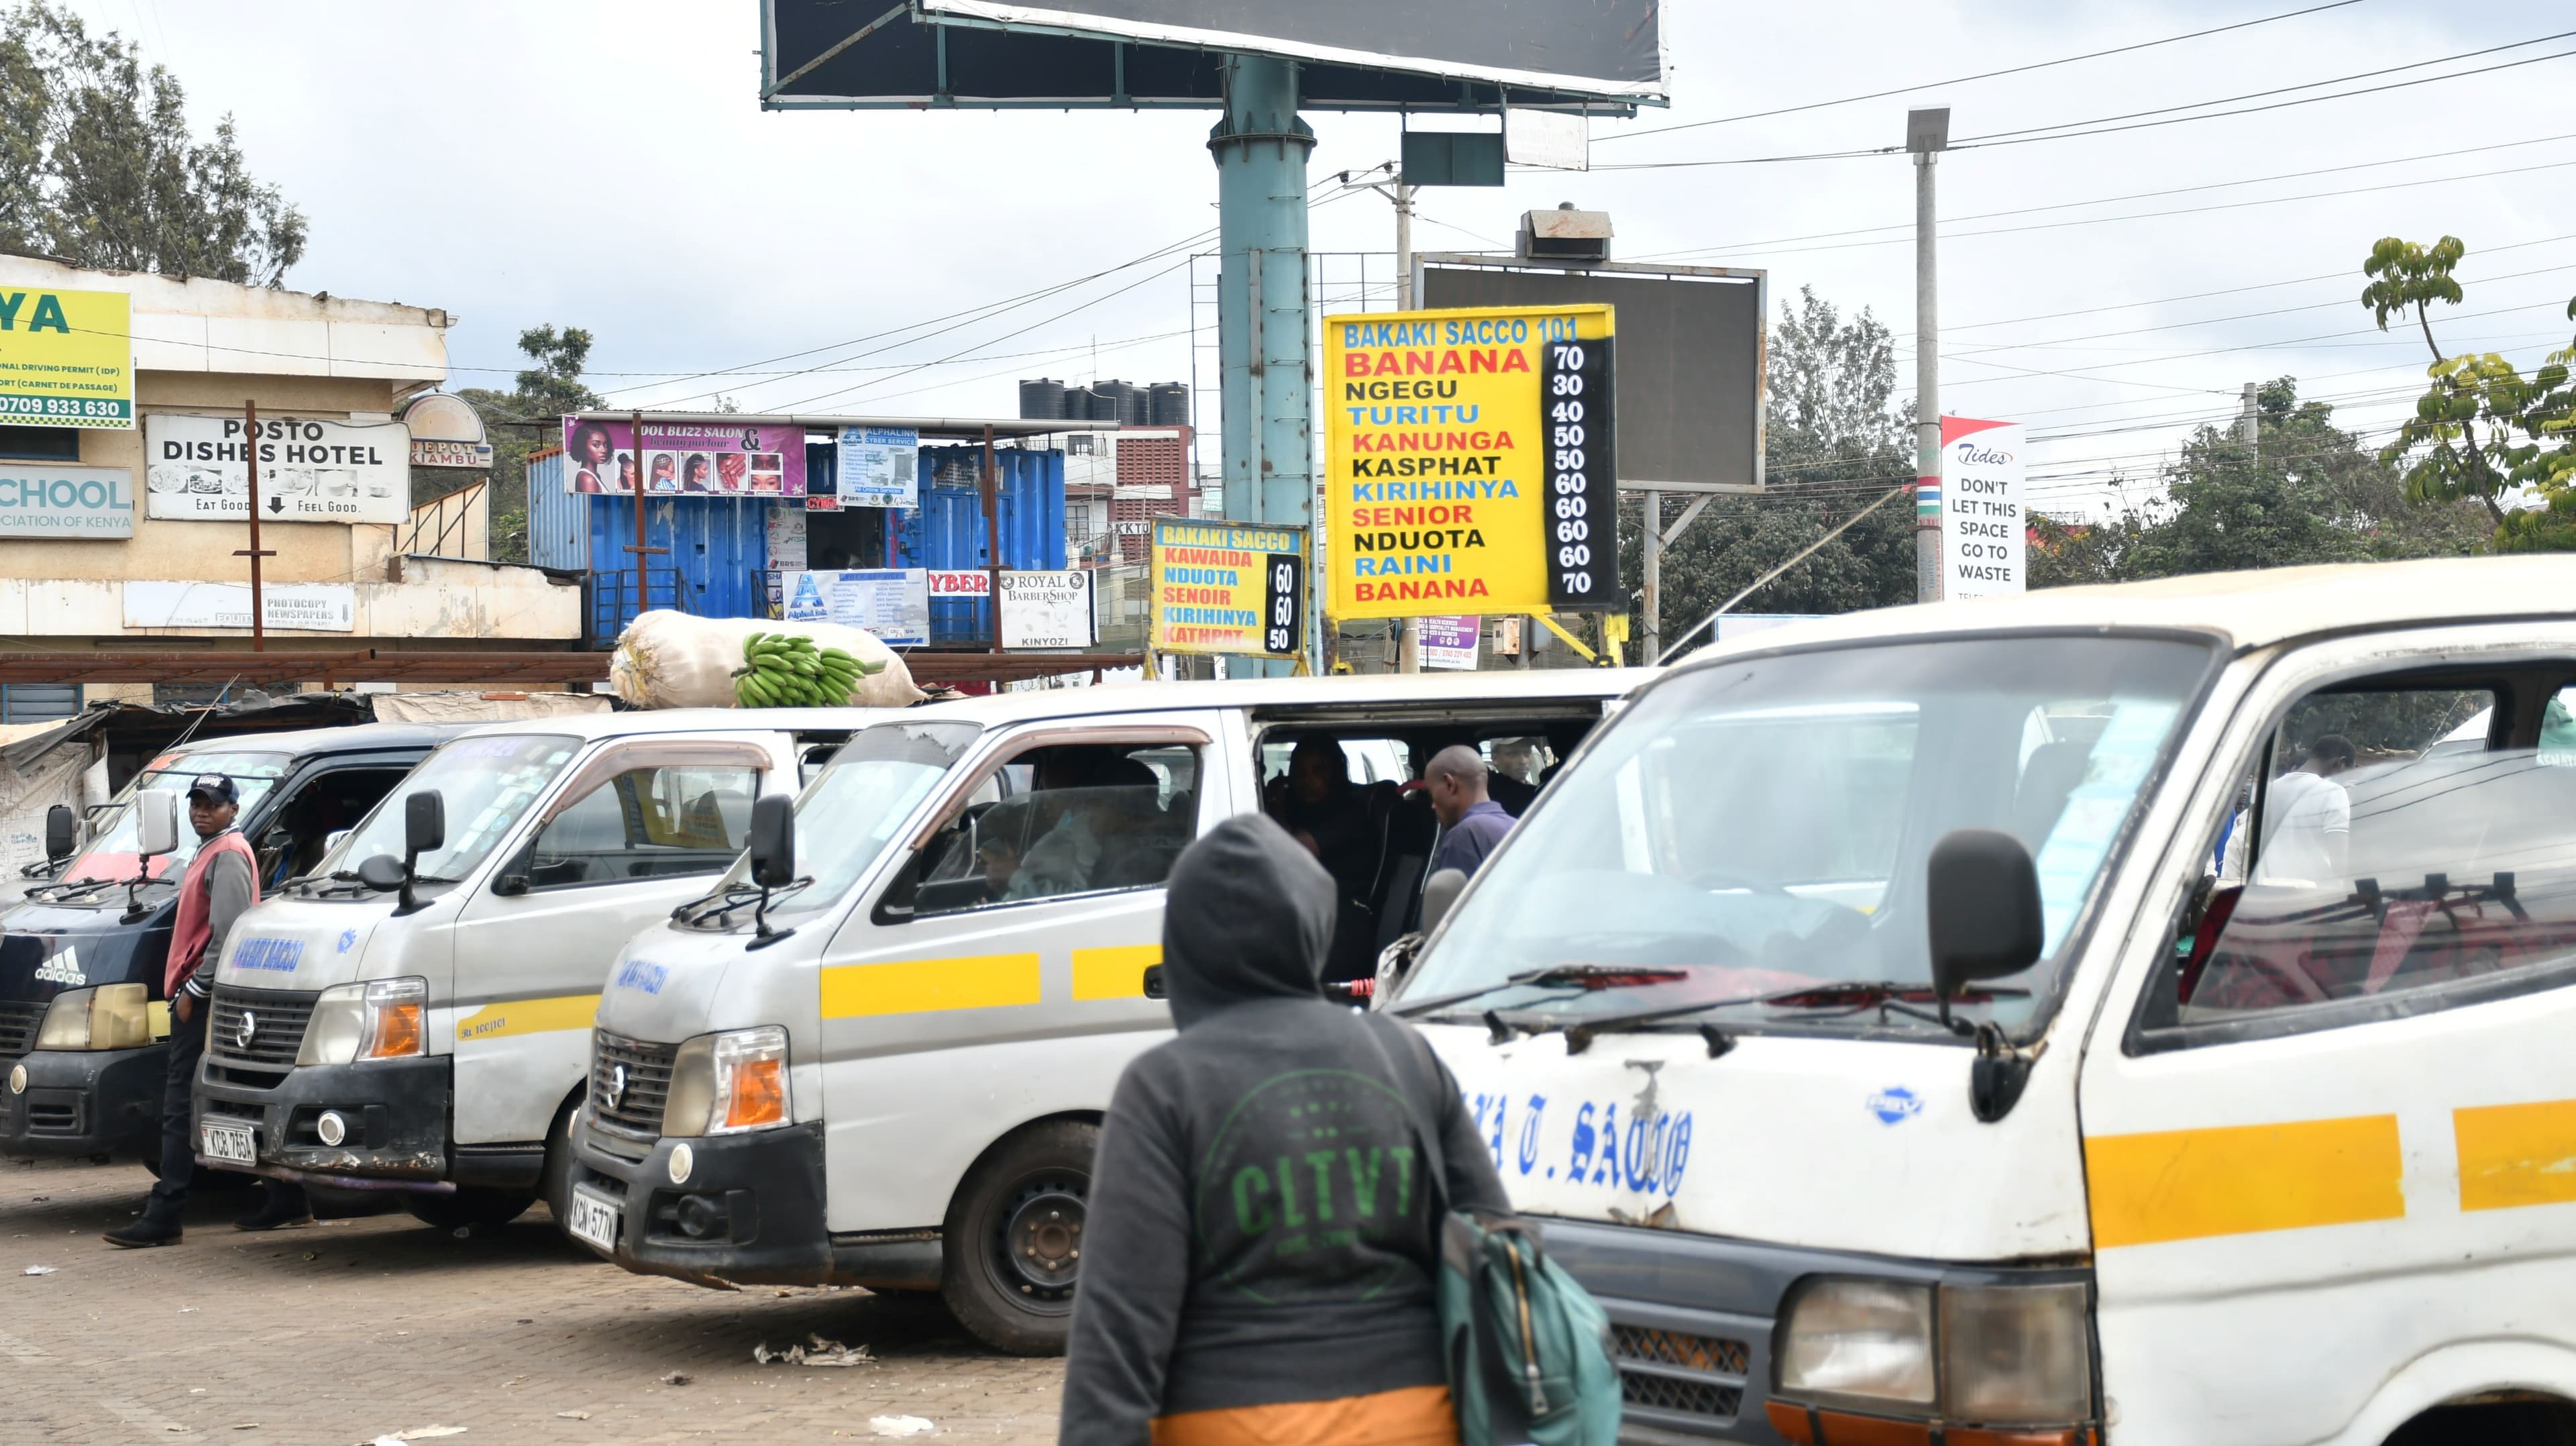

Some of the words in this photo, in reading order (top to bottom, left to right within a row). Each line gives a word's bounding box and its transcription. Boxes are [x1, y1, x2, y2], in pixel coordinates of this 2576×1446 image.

[1344, 321, 1436, 348] BAKAKI
[1445, 319, 1527, 344] SACCO
[1538, 317, 1577, 344] 101
[1345, 349, 1529, 377] BANANA
[1554, 346, 1584, 370] 70
[17, 379, 57, 389] (CARNET
[72, 383, 117, 393] PASSAGE)
[1346, 380, 1457, 401] NGEGU
[1553, 375, 1582, 395] 30
[0, 397, 42, 413] 0709
[47, 399, 80, 415] 933
[85, 401, 119, 416] 630
[1347, 405, 1479, 426] TURITU
[1552, 401, 1583, 422] 40
[224, 420, 324, 441] POSTO
[667, 426, 702, 437] BLIZZ
[704, 427, 744, 438] SALON
[741, 428, 761, 451] &
[867, 428, 916, 437] ALPHALINK
[1352, 431, 1514, 452] KANUNGA
[1554, 425, 1584, 447] 50
[164, 441, 276, 463] DISHES
[286, 445, 383, 465] HOTEL
[651, 437, 686, 448] beauty
[410, 454, 476, 464] KIAMBU
[1352, 456, 1501, 477] KASPHAT
[1554, 449, 1585, 470] 50
[1958, 444, 2006, 465] Tides
[0, 478, 131, 509] CHOOL
[1352, 480, 1519, 502] KIRIHINYA
[1555, 474, 1586, 494] 60
[1961, 478, 2008, 495] DON'T
[1352, 505, 1472, 527] SENIOR
[1556, 497, 1587, 519] 60
[1952, 499, 1978, 514] LET
[1982, 501, 2017, 517] THIS
[0, 515, 60, 527] CIATION
[64, 516, 83, 527] OF
[87, 517, 131, 527] KENYA
[1960, 521, 2008, 538] SPACE
[1163, 525, 1227, 548] BAKAKI
[1232, 531, 1290, 551] SACCO
[1354, 529, 1485, 552] NDUOTA
[1557, 521, 1588, 542] 60
[1165, 548, 1252, 567] KAWAIDA
[1355, 554, 1451, 576] RAINI
[1559, 545, 1590, 567] 60
[1961, 543, 1983, 557] GO
[1988, 545, 2008, 560] TO
[1018, 576, 1065, 588] ROYAL
[1164, 567, 1238, 586] NDUOTA
[1276, 564, 1292, 593] 60
[1958, 564, 2011, 582] WASTE
[1164, 587, 1231, 605] SENOIR
[1355, 578, 1489, 601] BANANA
[1563, 572, 1592, 593] 70
[268, 599, 327, 608] PHOTOCOPY
[268, 610, 333, 619] NEWSPAPERS
[1163, 607, 1256, 626] KIRIHINYA
[1276, 597, 1292, 626] 60
[1022, 637, 1068, 646] KINYOZI
[1270, 629, 1288, 649] 50
[35, 962, 87, 986] adidas
[1232, 1146, 1413, 1235] CLTVT
[573, 1196, 588, 1233] KCN
